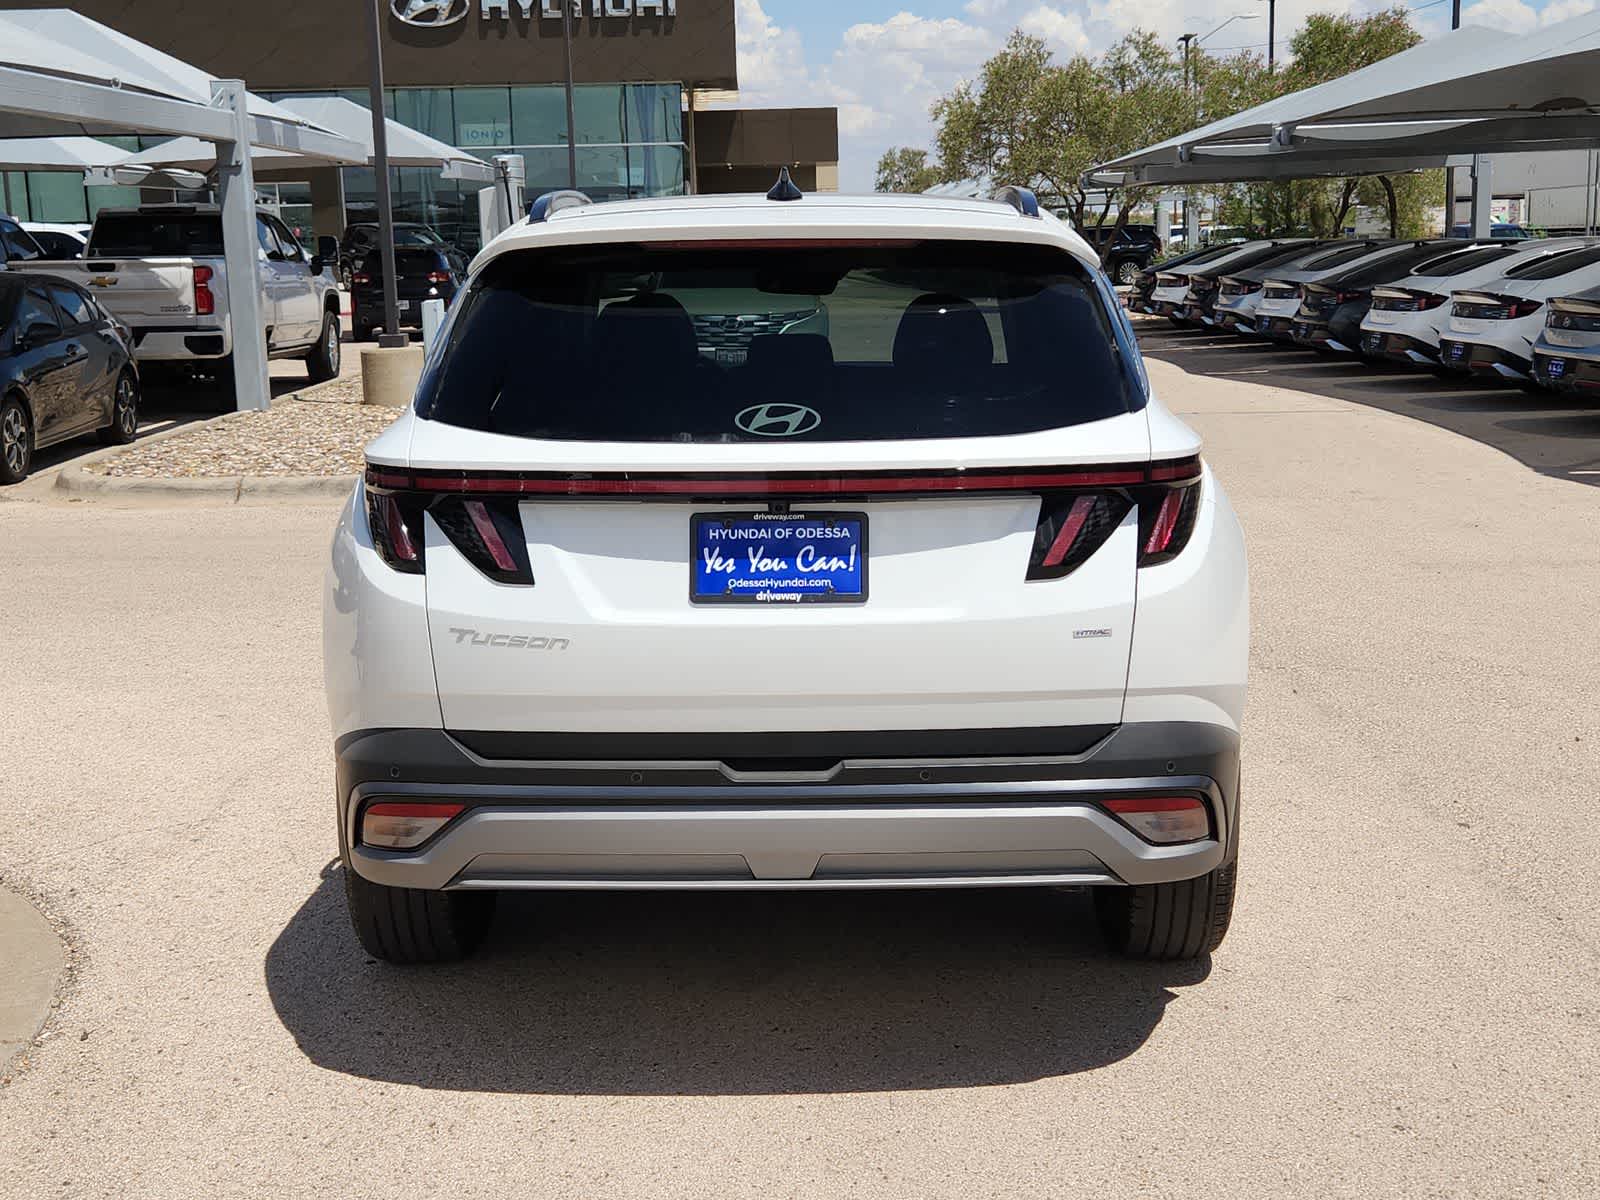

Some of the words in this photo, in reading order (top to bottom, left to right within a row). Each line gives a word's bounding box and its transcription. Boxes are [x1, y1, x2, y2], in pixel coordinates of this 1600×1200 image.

[753, 513, 805, 521] driveway.com
[709, 528, 771, 540] HYUNDAI
[774, 528, 793, 539] OF
[795, 528, 850, 539] ODESSA
[703, 545, 736, 574] Yes
[748, 545, 788, 574] You
[796, 544, 857, 573] Can!
[728, 578, 832, 588] OdessaHyundai.com
[756, 590, 802, 602] driveway
